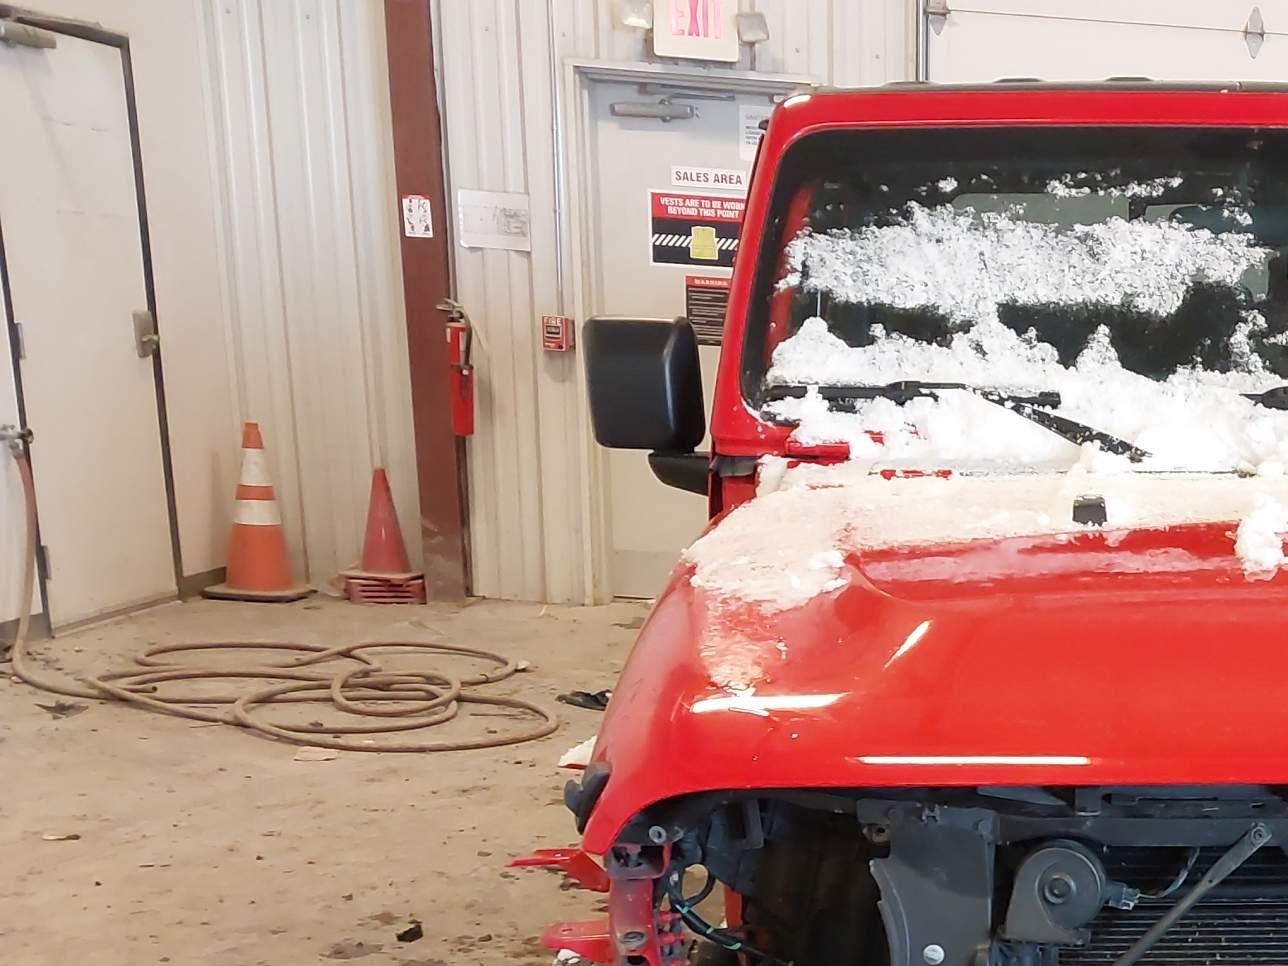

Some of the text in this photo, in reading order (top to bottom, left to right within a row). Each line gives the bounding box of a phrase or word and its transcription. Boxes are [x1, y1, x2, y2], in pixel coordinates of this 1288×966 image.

[675, 170, 743, 185] SALES AREA
[660, 197, 684, 206] VESTS
[684, 199, 700, 208] ARE
[701, 200, 711, 208] TO
[712, 201, 722, 209] BE
[667, 206, 740, 219] BEYOND THIS POINT
